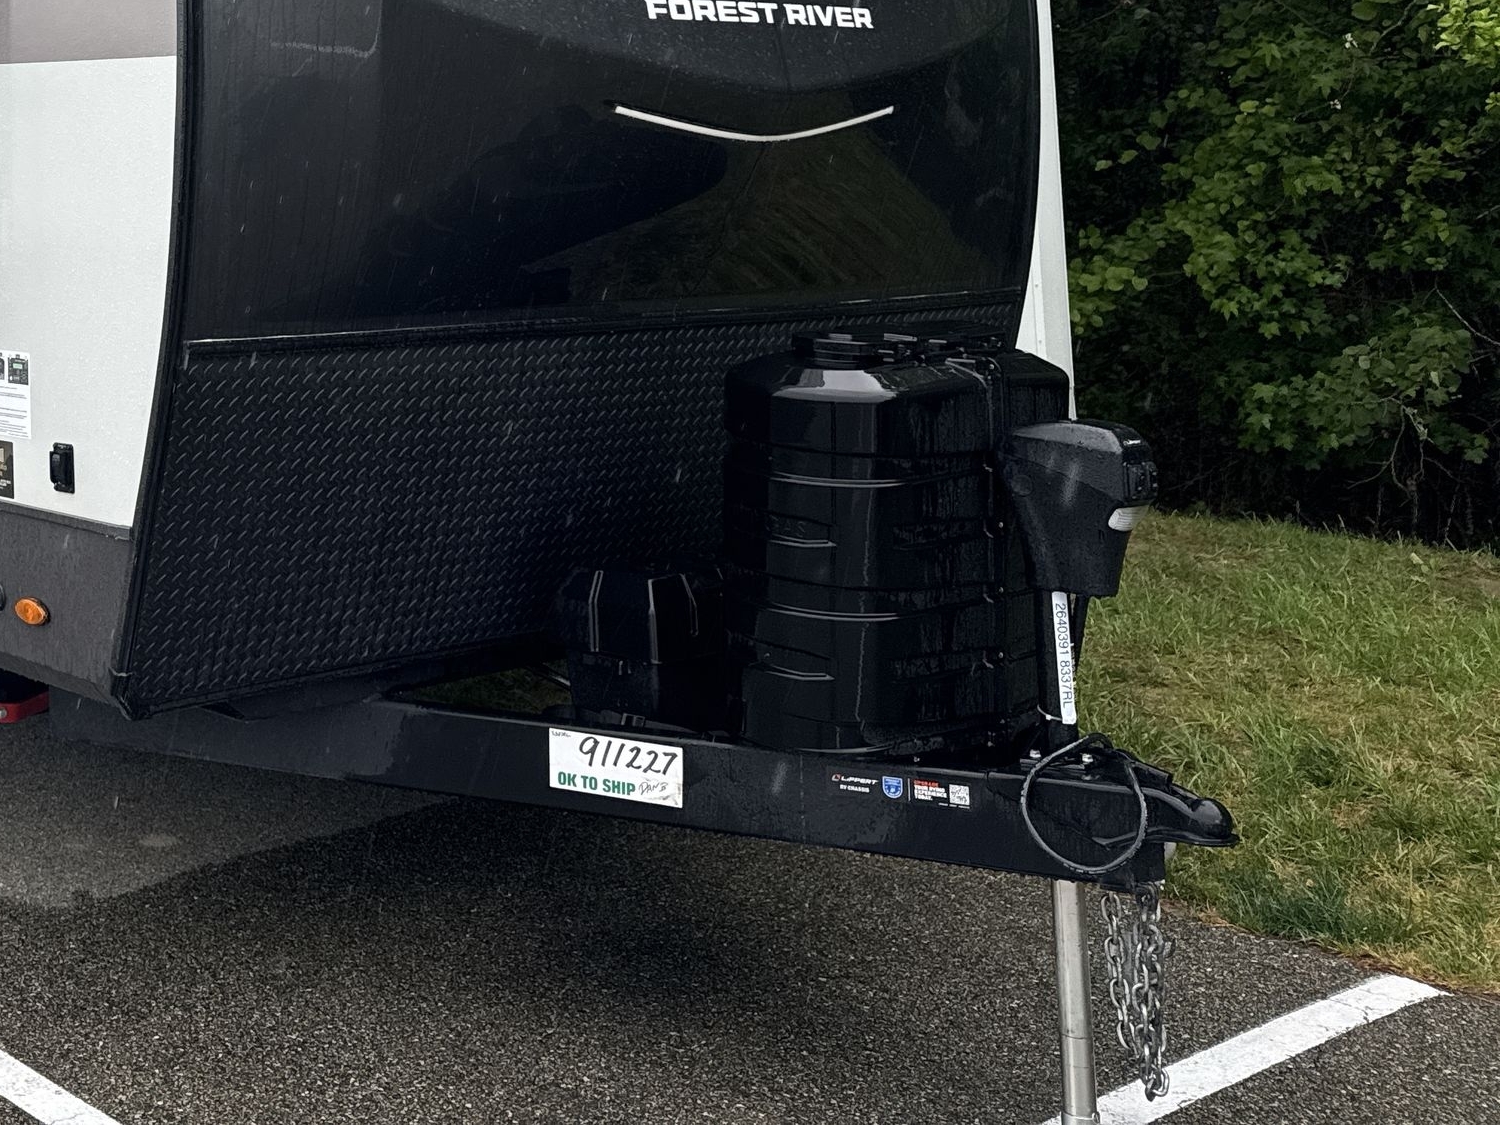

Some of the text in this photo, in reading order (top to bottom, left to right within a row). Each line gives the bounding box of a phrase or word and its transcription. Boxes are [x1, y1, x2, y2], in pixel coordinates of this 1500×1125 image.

[782, 3, 874, 29] RIVER
[1055, 603, 1073, 709] 2640391 8337RL
[579, 736, 678, 776] 911227
[557, 771, 636, 796] OK TO SHIP
[841, 776, 879, 785] LIPPERT
